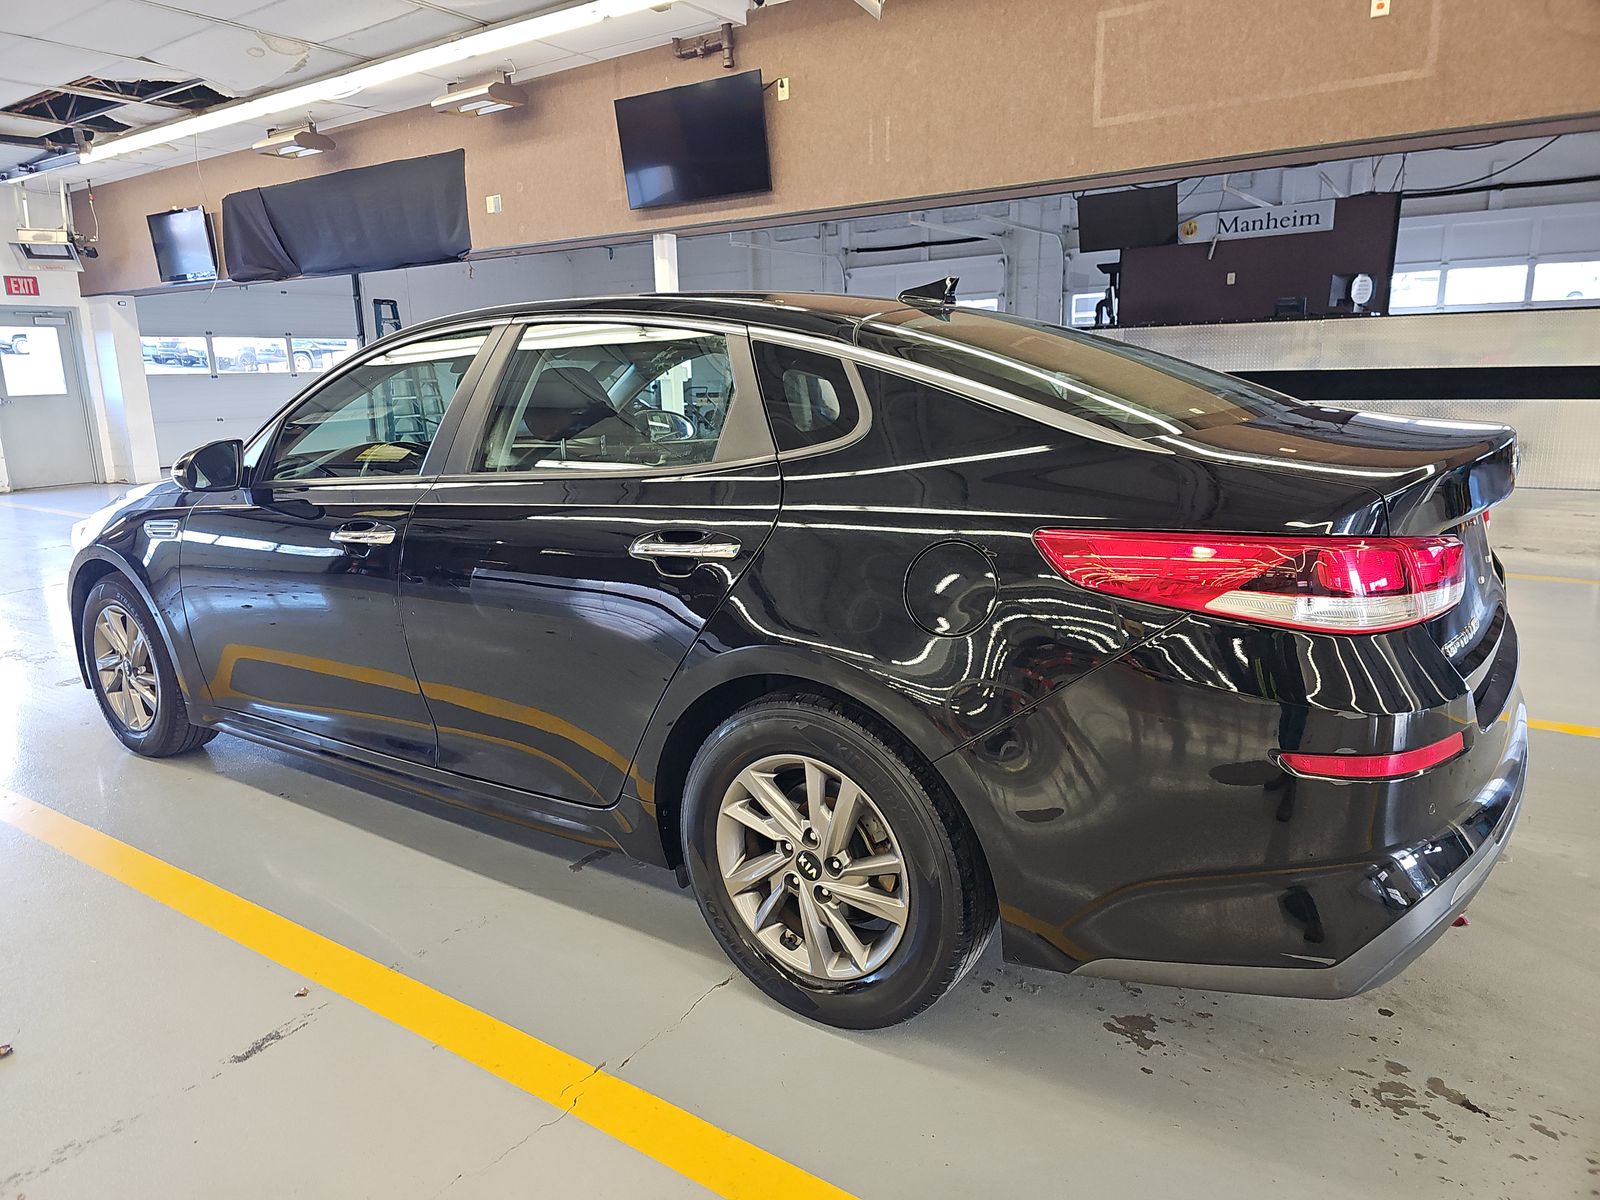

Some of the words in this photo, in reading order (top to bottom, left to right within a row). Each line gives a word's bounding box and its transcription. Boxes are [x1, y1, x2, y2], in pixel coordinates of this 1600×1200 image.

[1218, 209, 1320, 235] Manheim
[10, 277, 35, 295] EXIT
[798, 853, 818, 879] KIA
